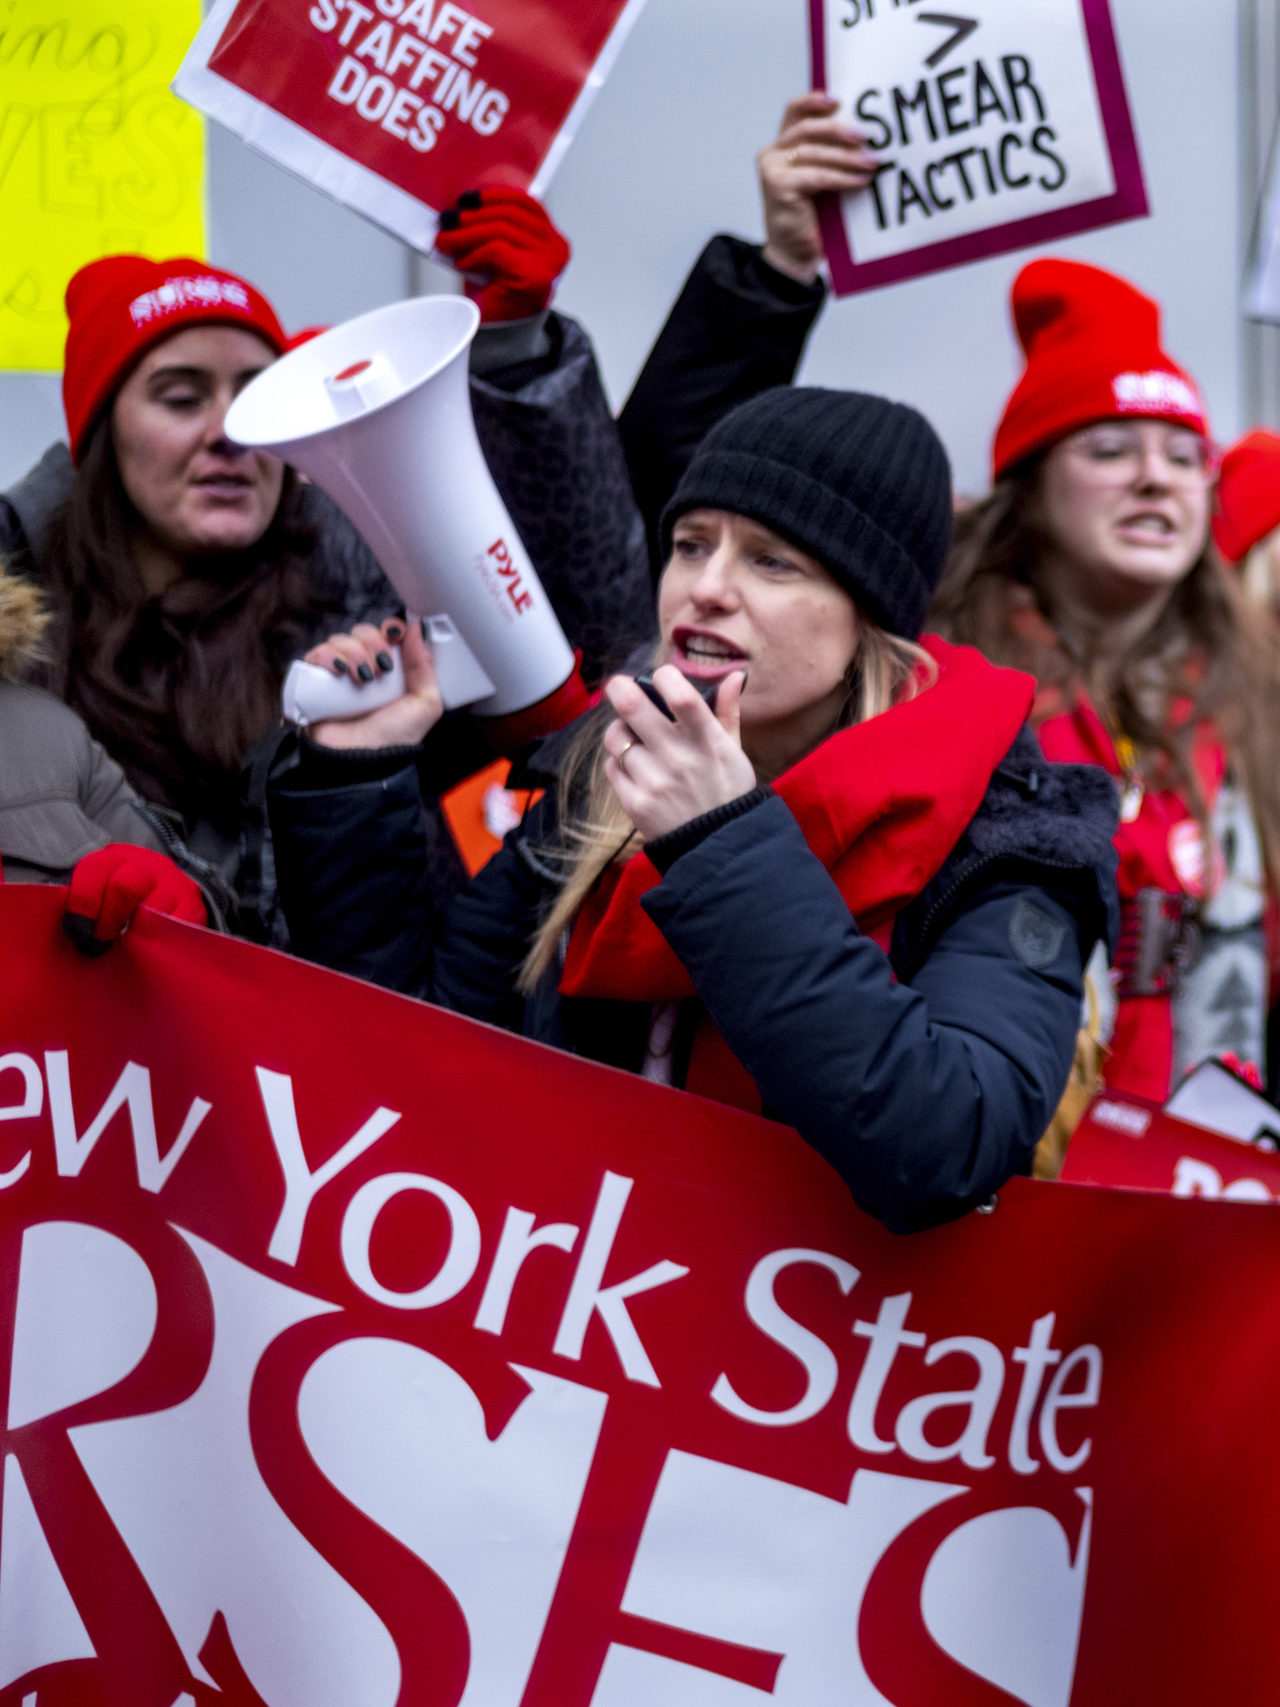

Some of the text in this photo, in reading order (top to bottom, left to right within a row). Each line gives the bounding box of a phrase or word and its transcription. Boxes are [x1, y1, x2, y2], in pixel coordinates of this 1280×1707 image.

[309, 0, 510, 136] STAFFING
[327, 55, 446, 152] DOES
[855, 55, 1047, 150] SMEAR
[868, 126, 1067, 230] TACTICS
[487, 537, 534, 616] PYLE
[255, 1065, 690, 1390] York
[710, 1247, 1102, 1475] State
